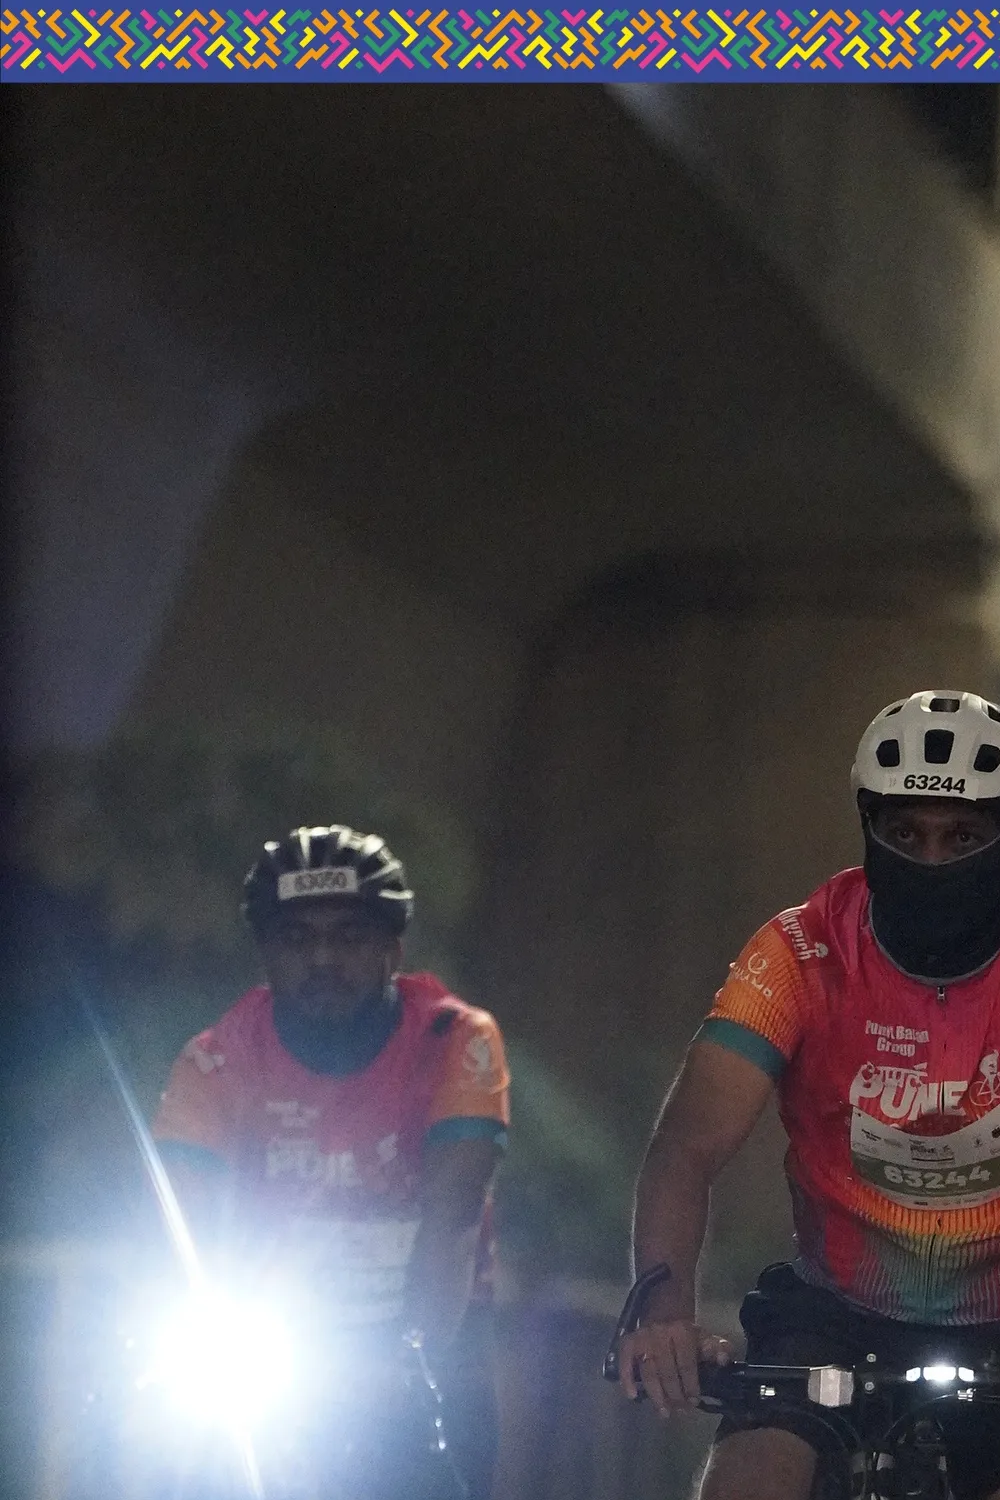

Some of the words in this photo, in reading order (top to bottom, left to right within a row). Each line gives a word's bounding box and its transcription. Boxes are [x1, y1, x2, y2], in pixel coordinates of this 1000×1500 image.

[904, 774, 966, 794] 63244
[876, 1036, 916, 1058] Group
[849, 1076, 968, 1121] PUNE
